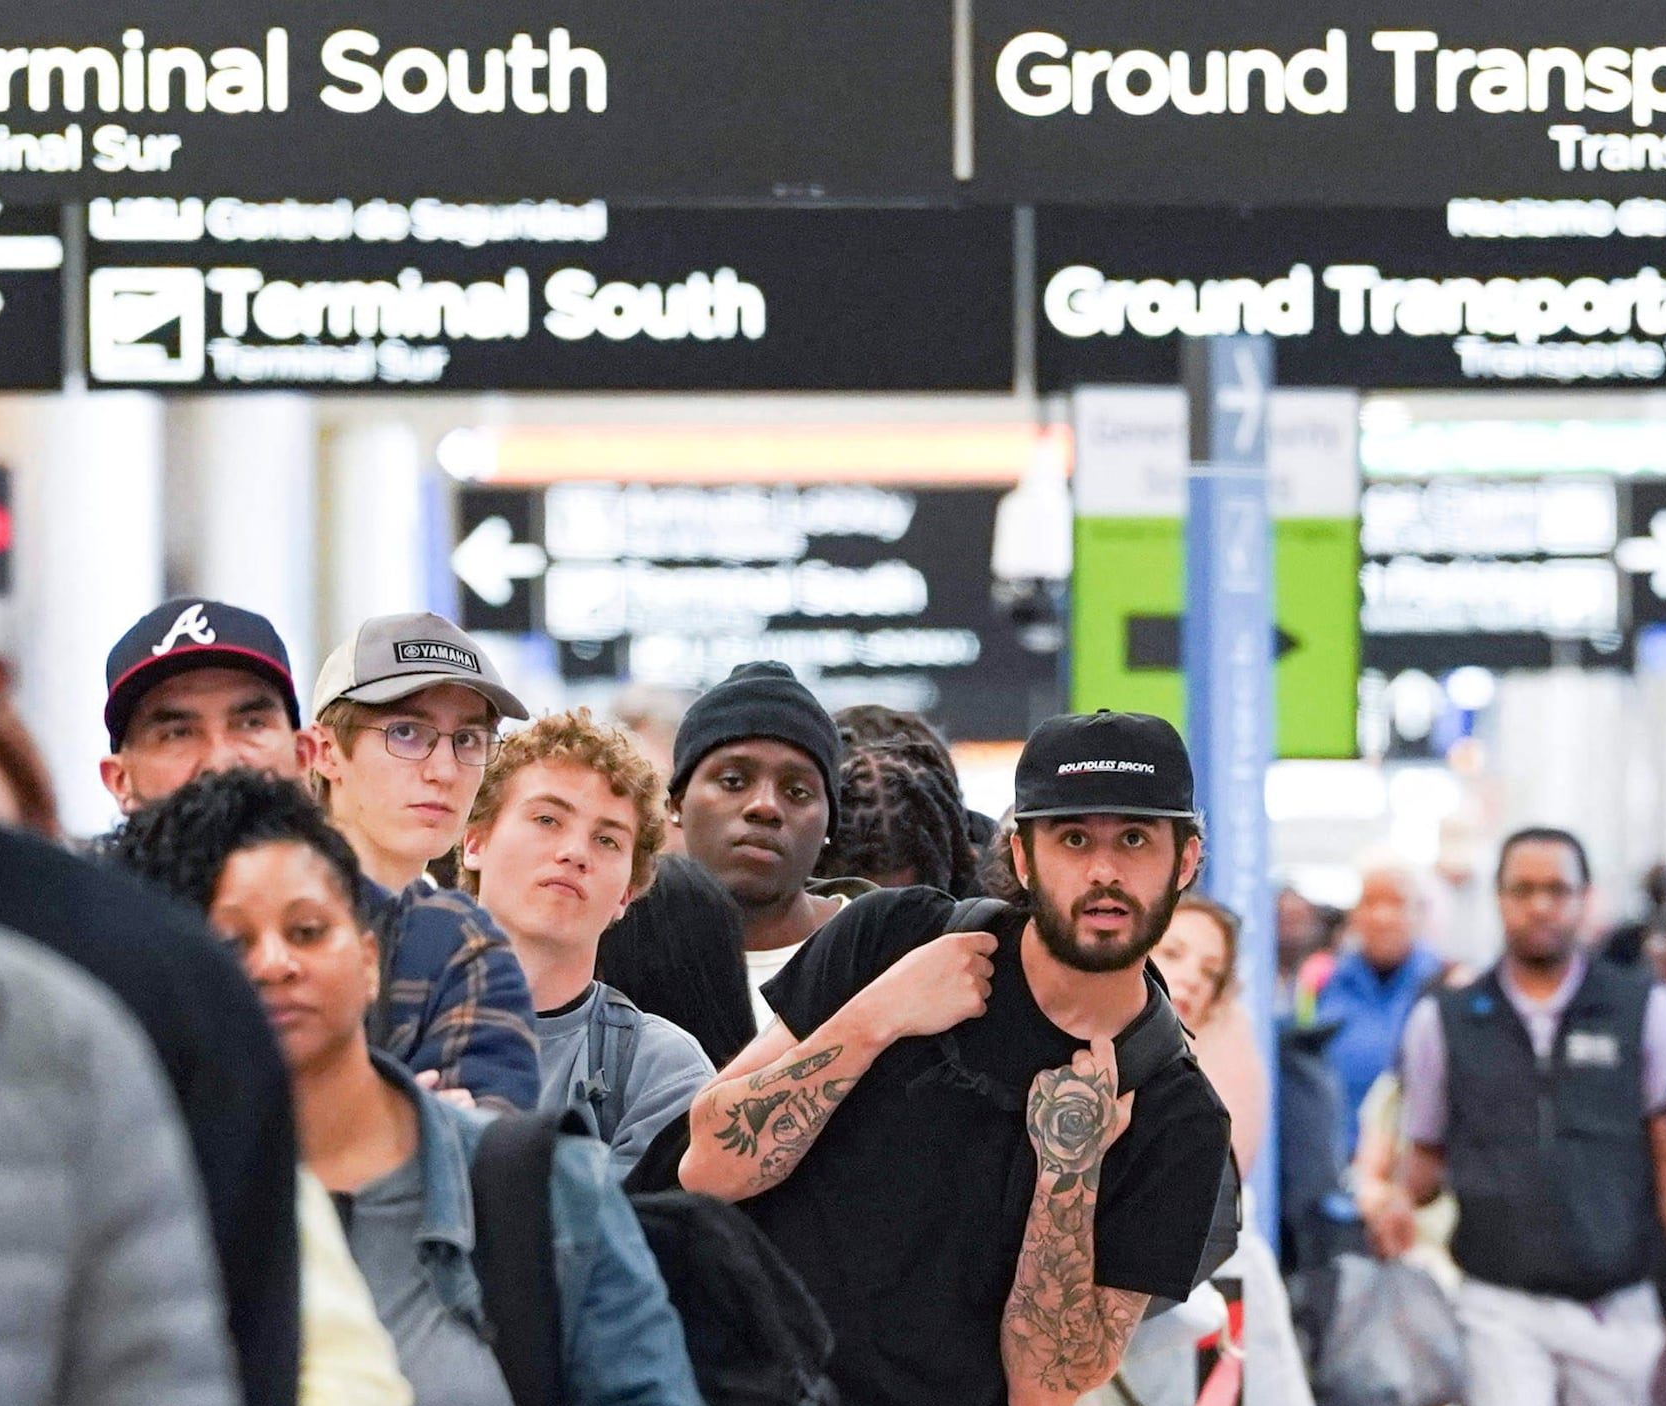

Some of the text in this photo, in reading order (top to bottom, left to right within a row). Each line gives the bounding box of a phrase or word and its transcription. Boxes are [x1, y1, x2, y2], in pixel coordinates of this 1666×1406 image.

[318, 27, 609, 114] South
[994, 28, 1349, 117] Ground
[91, 123, 182, 173] Sur
[203, 266, 767, 340] Terminal South
[1043, 263, 1315, 334] Ground
[151, 603, 217, 657] A
[419, 644, 474, 668] YAMAHA
[1057, 760, 1155, 773] BOUNDLESS RACING
